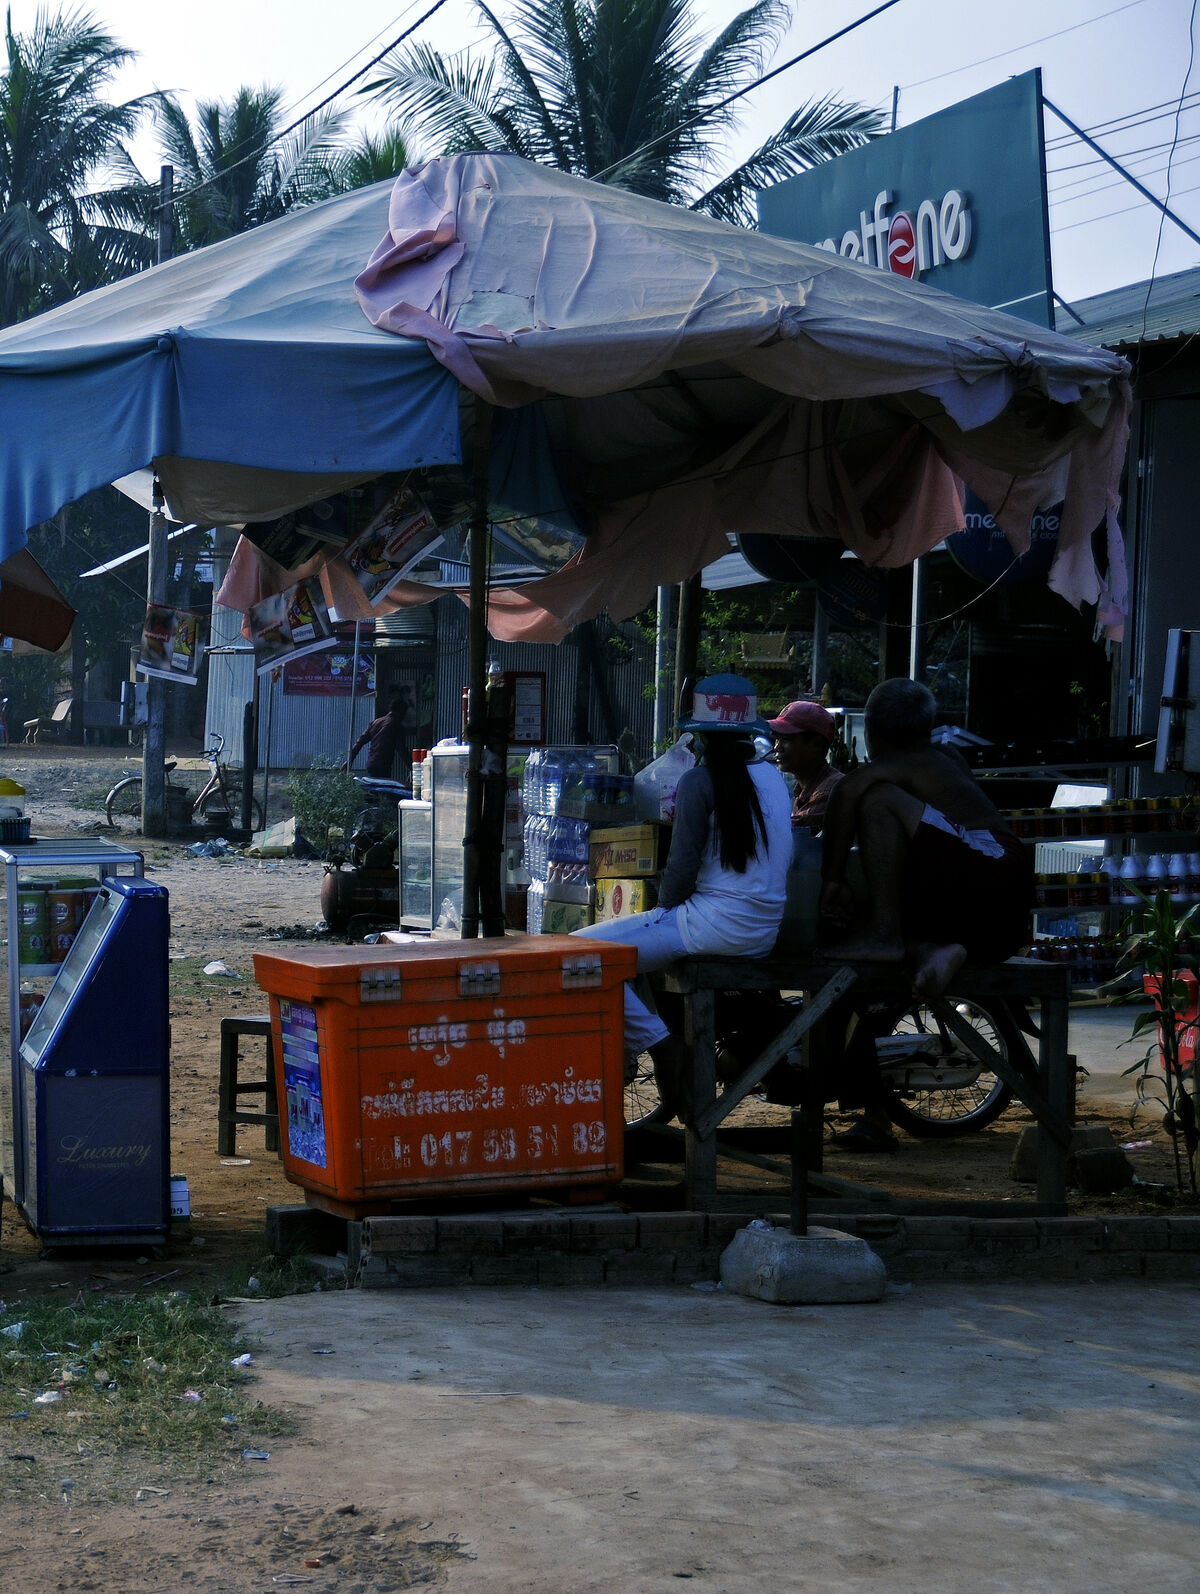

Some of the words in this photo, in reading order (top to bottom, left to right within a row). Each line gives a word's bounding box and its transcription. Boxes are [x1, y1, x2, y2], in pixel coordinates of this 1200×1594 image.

[814, 189, 972, 280] etfone
[56, 1134, 152, 1167] Luxury
[421, 1130, 472, 1167] 017
